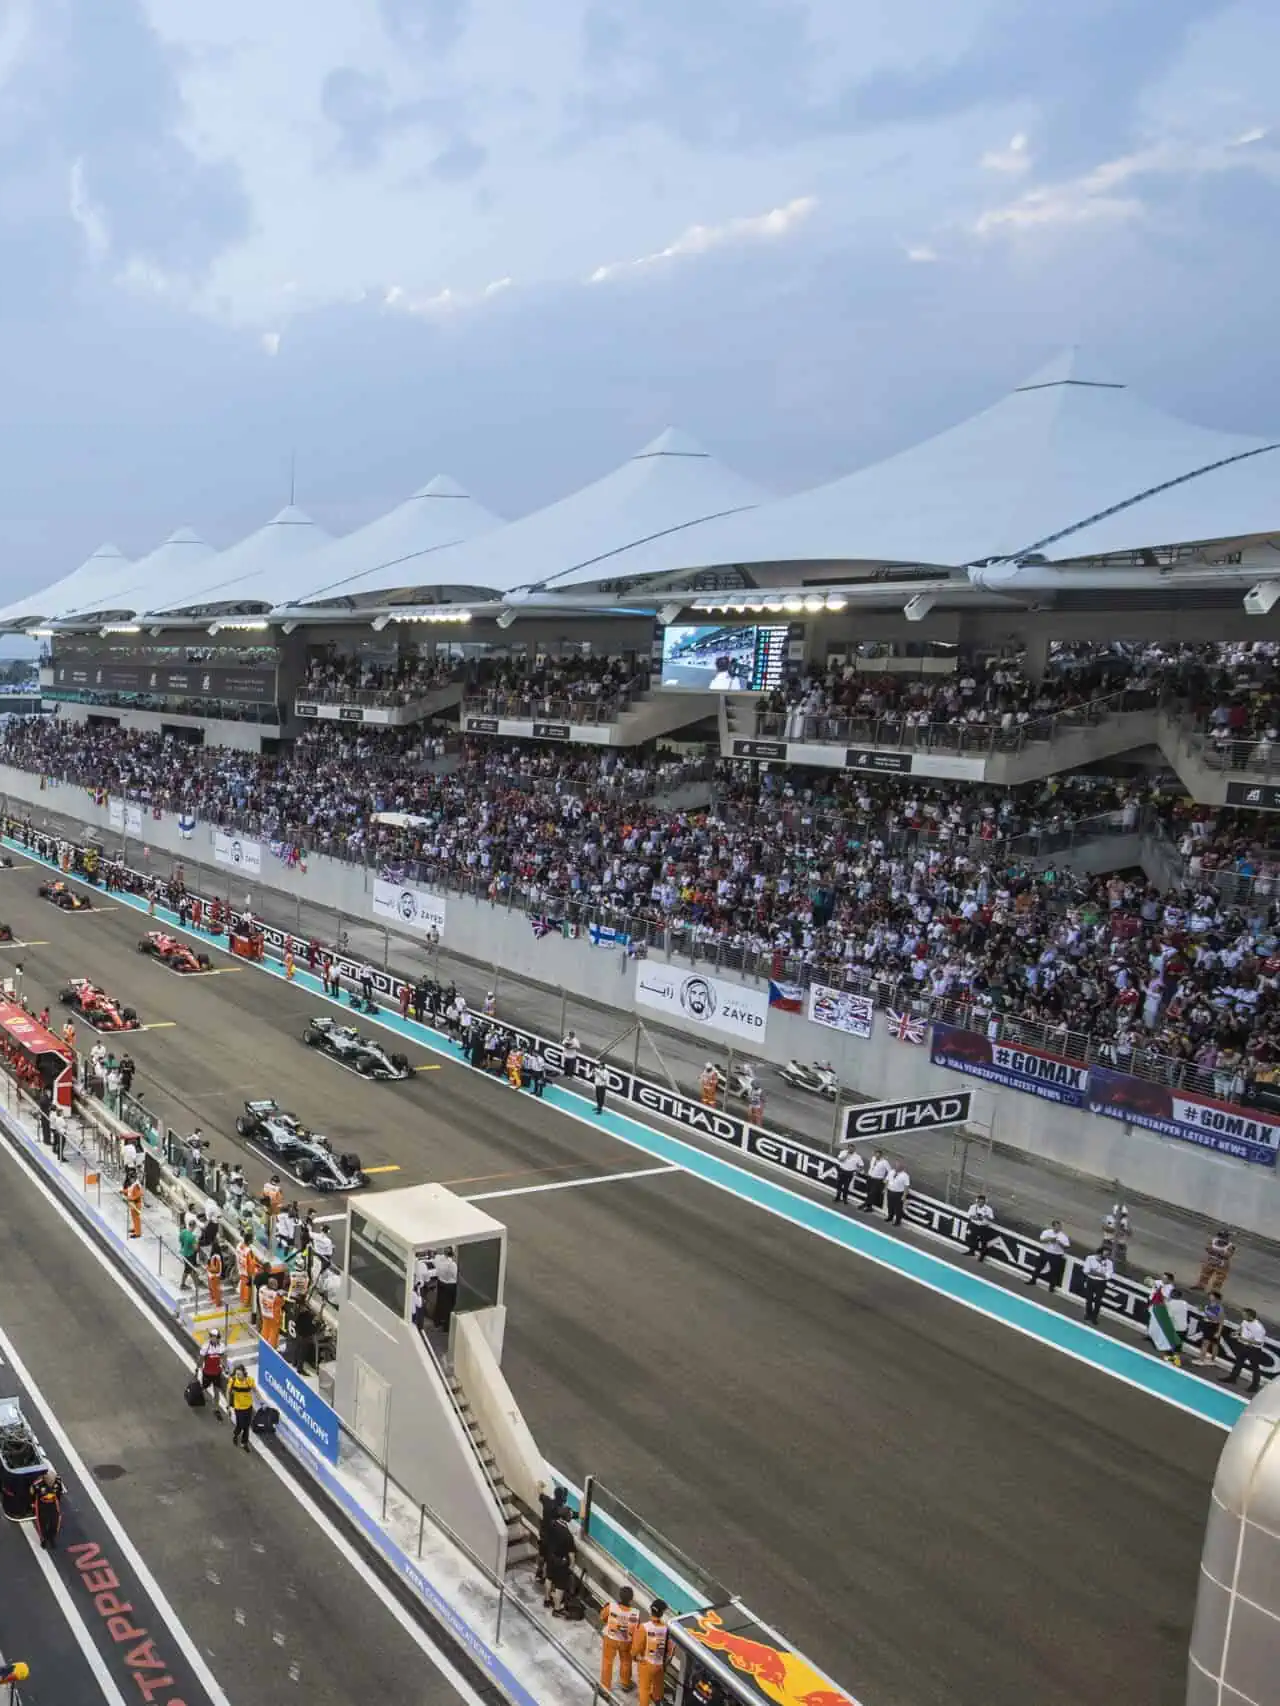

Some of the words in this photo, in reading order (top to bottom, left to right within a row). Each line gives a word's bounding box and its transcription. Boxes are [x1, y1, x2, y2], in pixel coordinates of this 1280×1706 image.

[722, 1006, 763, 1027] ZAYED
[996, 1048, 1081, 1088] #GOMAX
[639, 1087, 735, 1139] ETIHAD
[855, 1100, 962, 1132] ETIHAD
[1184, 1106, 1273, 1144] #GOMAX
[1125, 1111, 1181, 1137] VERSTAPPEN
[1183, 1126, 1216, 1148] LATEST
[1217, 1140, 1248, 1158] NEWS
[264, 1370, 329, 1445] COMMUNICATIONS
[285, 1378, 306, 1408] TATA
[65, 1542, 187, 1706] TAPPEN
